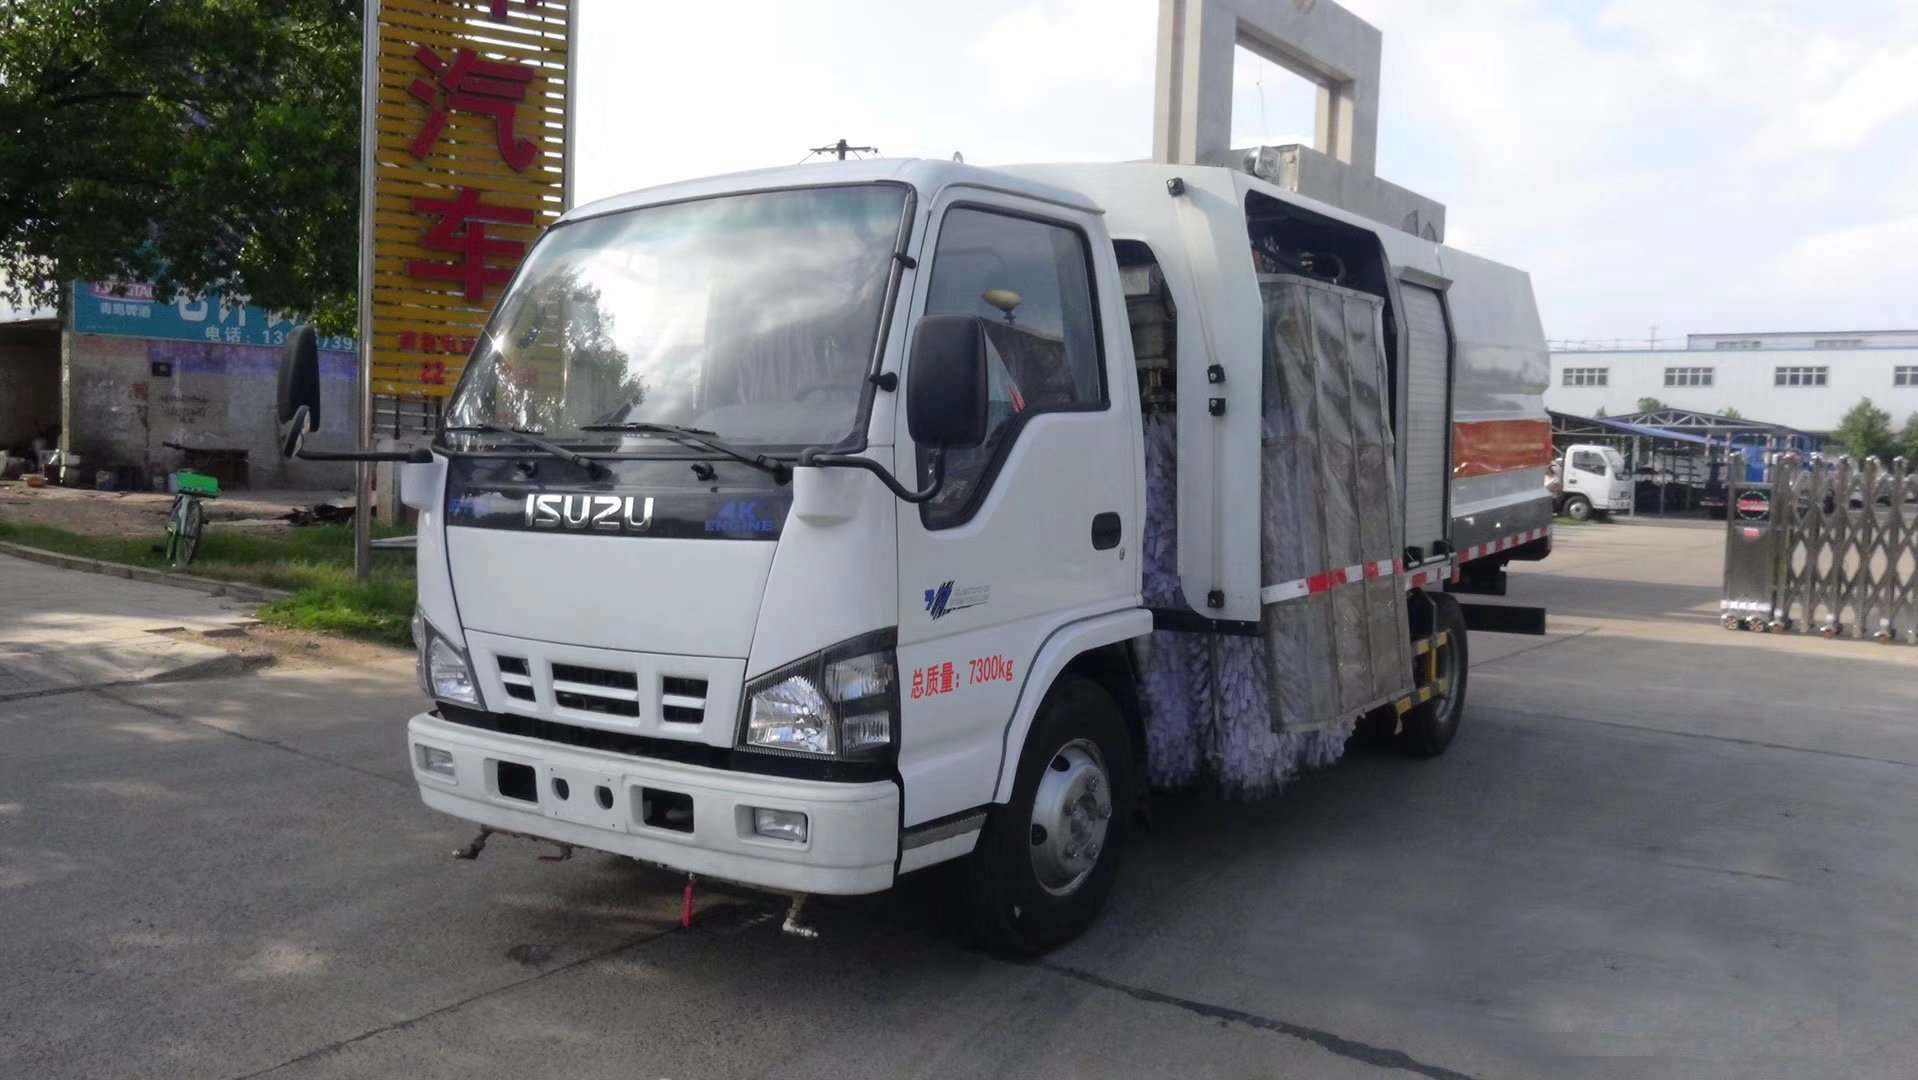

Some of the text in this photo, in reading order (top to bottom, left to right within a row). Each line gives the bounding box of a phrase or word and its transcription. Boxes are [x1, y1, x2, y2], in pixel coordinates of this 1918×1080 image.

[407, 0, 538, 302] 汽车
[524, 493, 655, 532] ISUZU
[704, 519, 774, 533] ENGINE
[968, 654, 1015, 686] 7300kg
